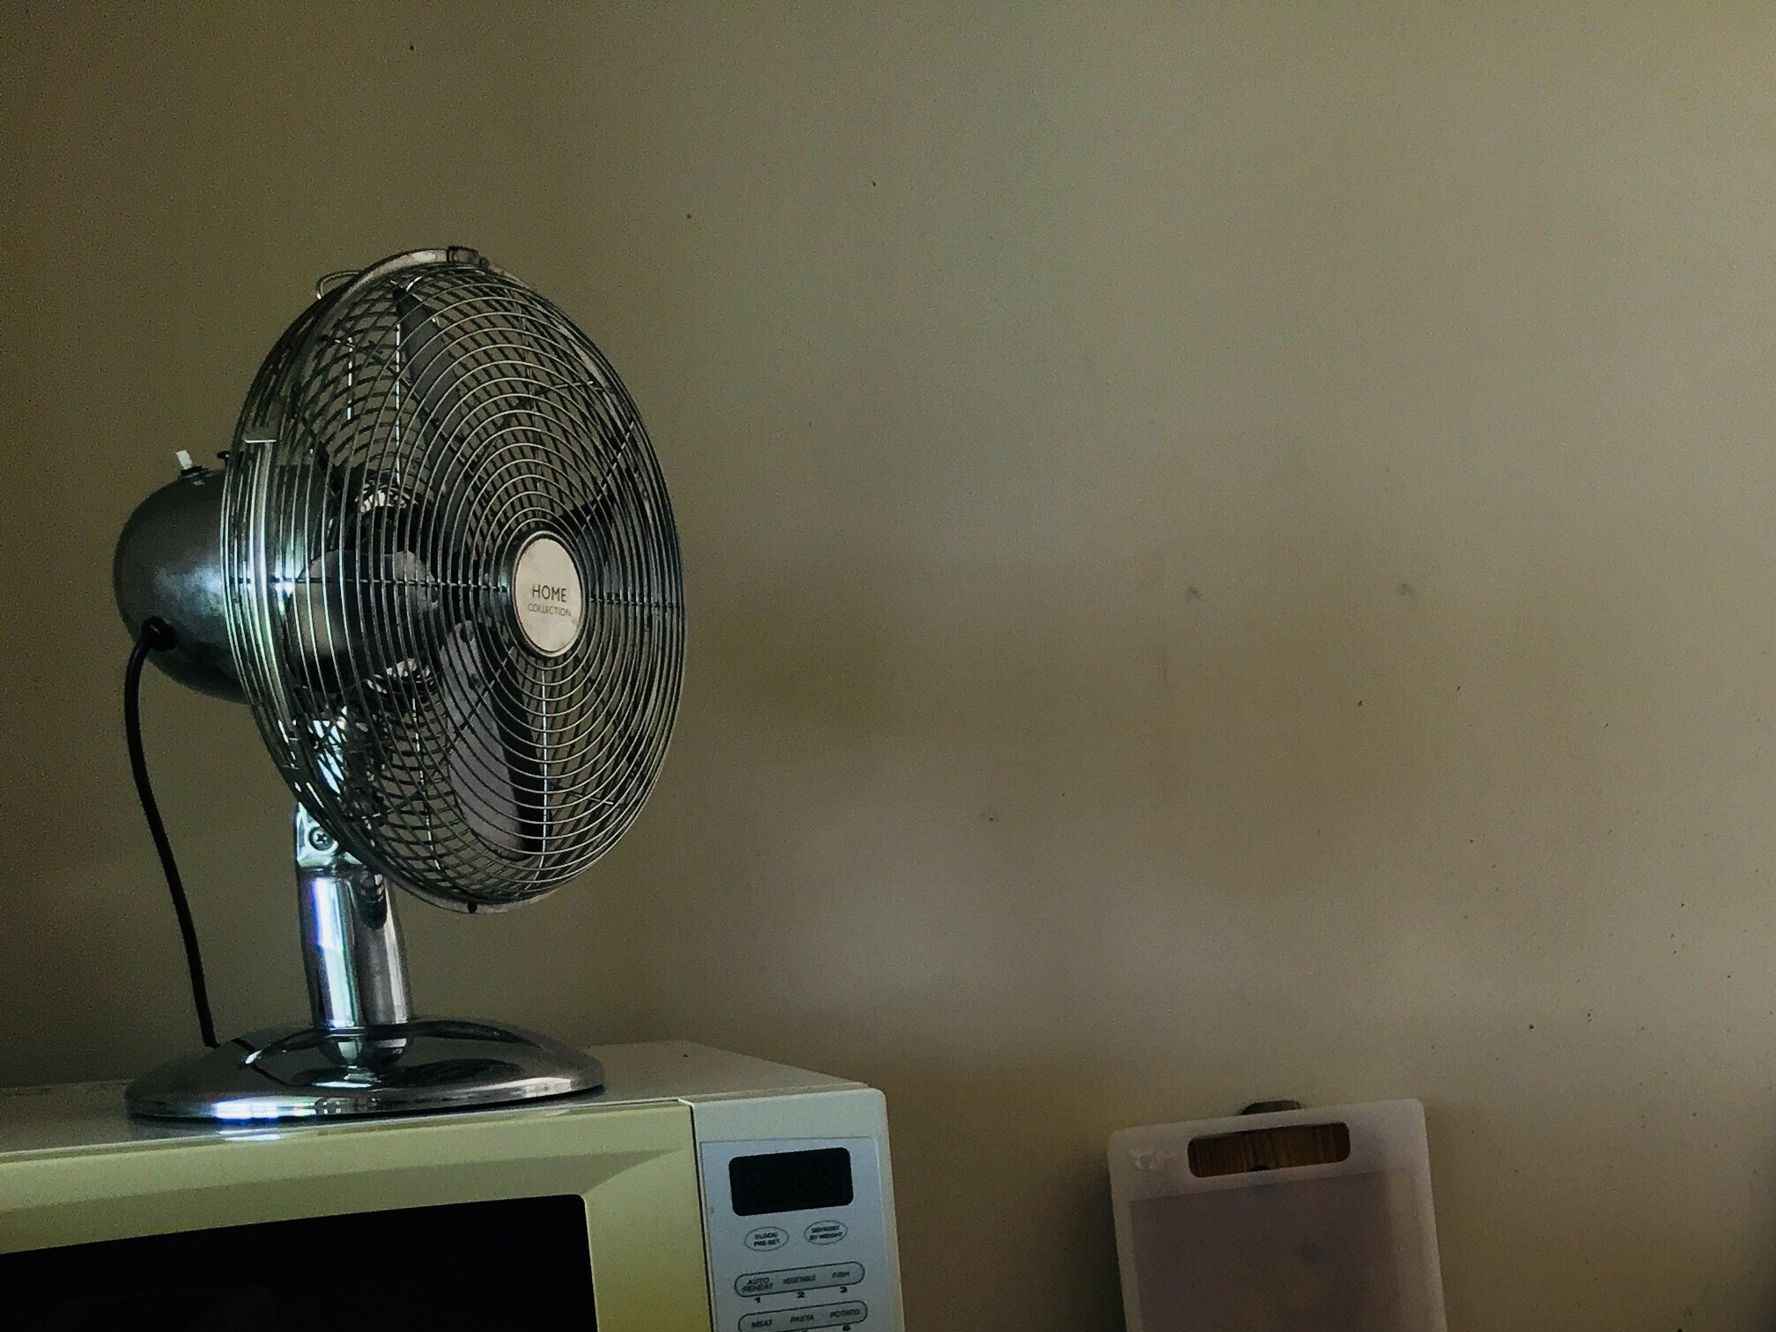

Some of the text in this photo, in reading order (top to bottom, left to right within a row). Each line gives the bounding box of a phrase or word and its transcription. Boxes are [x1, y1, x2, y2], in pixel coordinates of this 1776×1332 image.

[532, 584, 567, 603] HOME
[527, 602, 571, 617] COLLECTION
[797, 1291, 805, 1299] 2
[840, 1286, 848, 1294] 3
